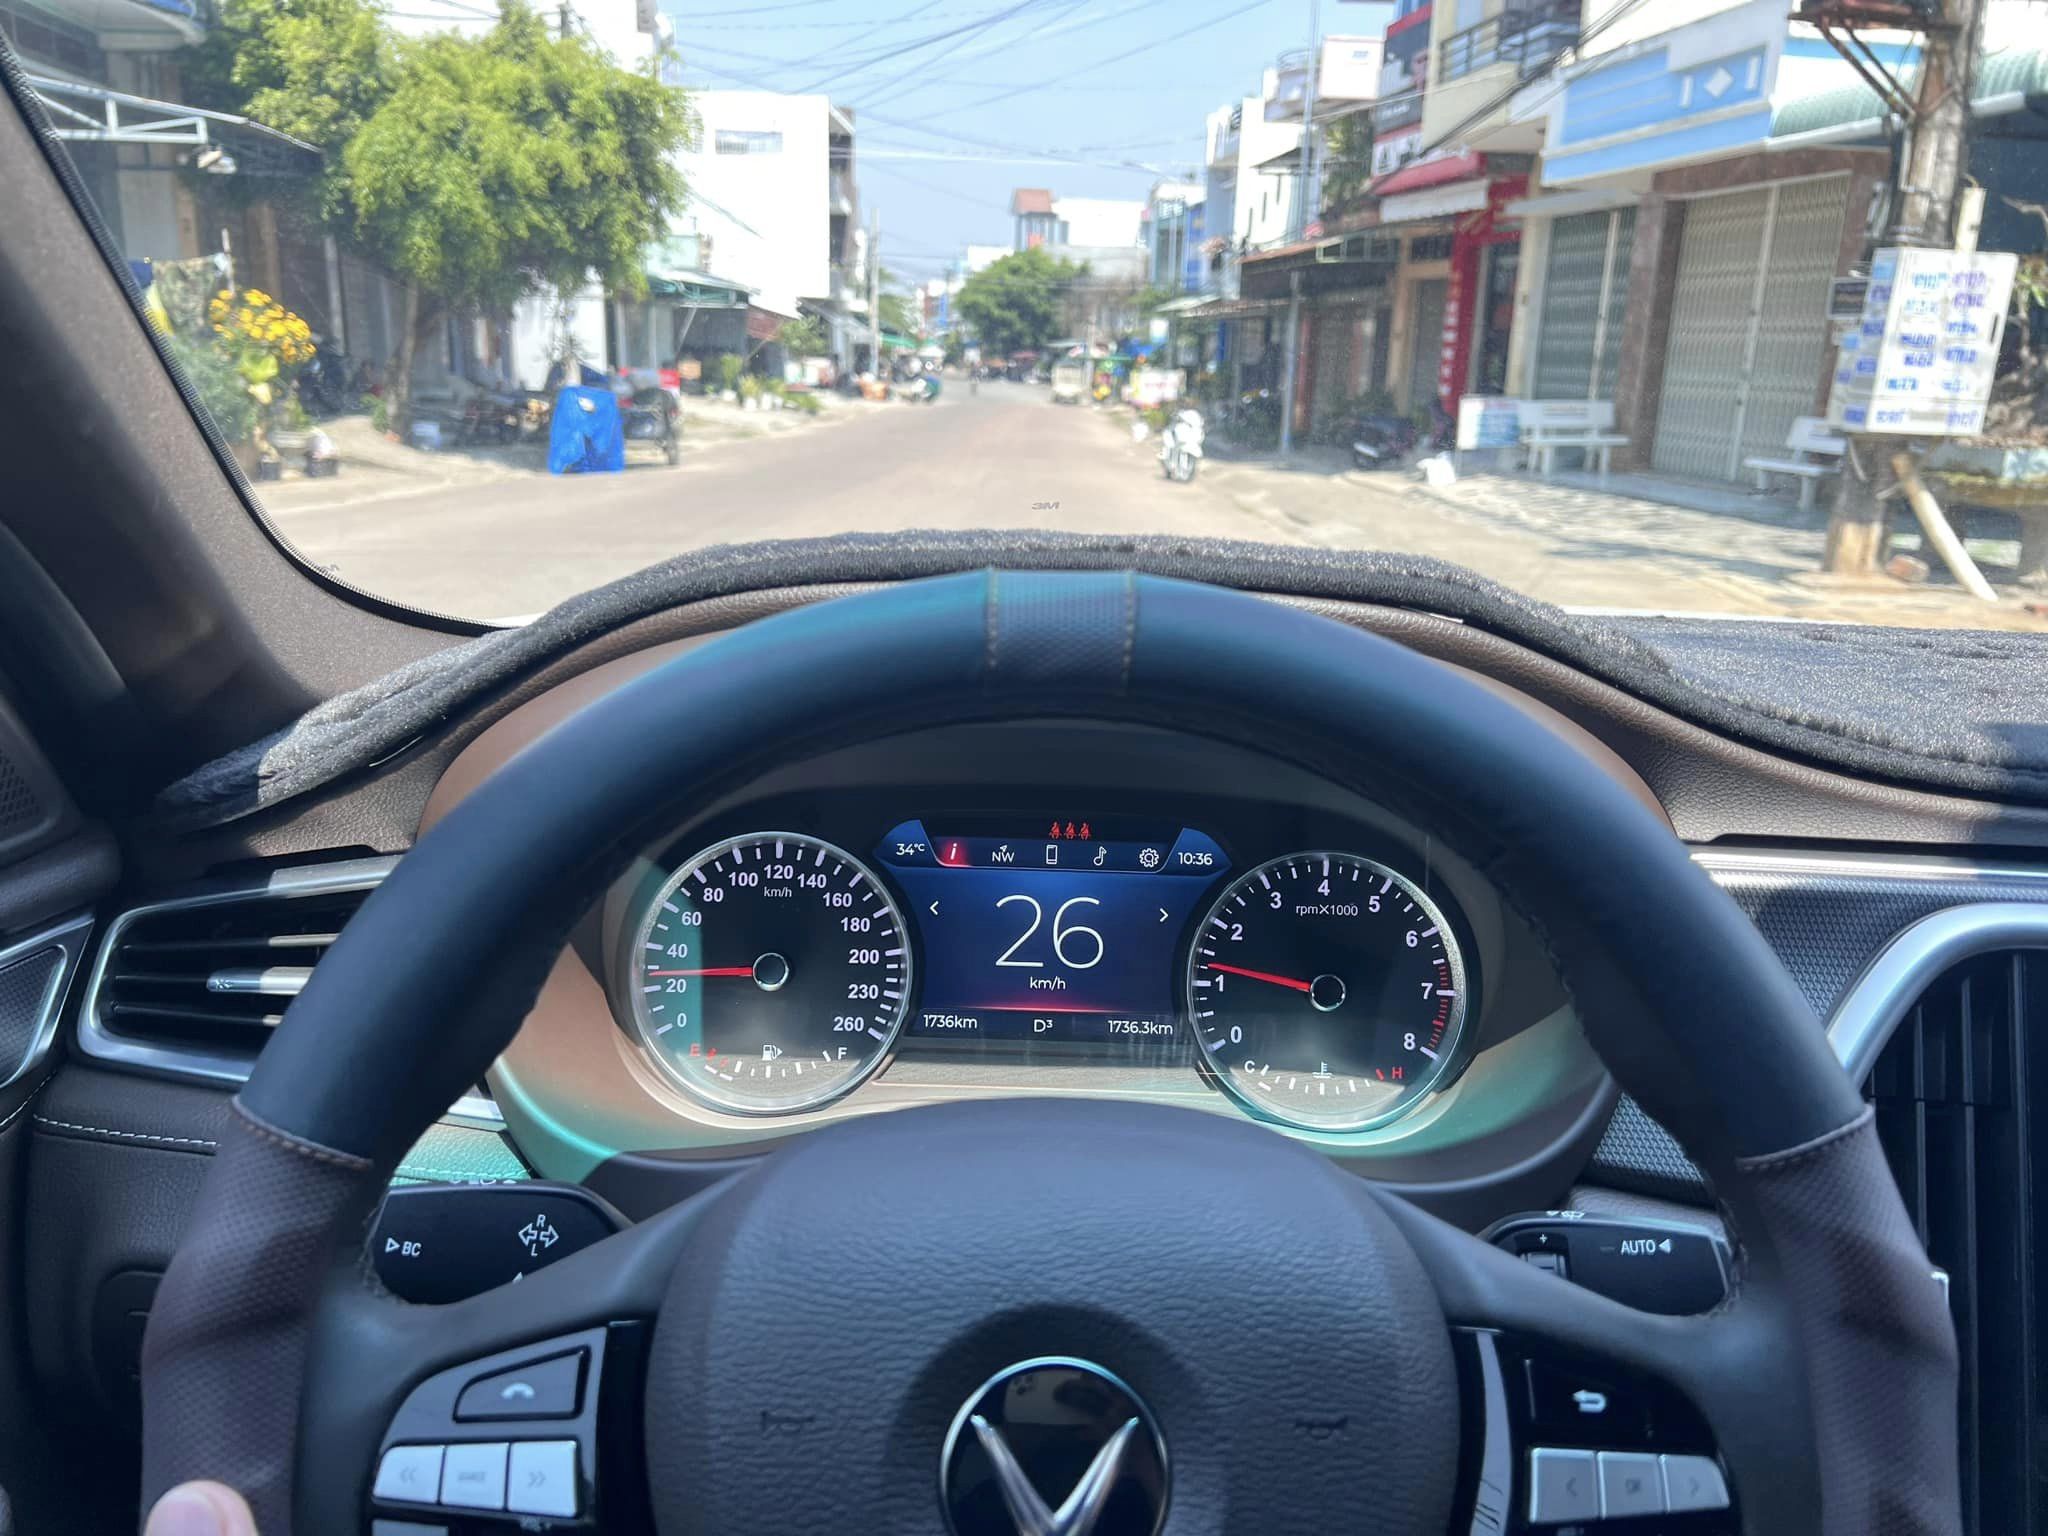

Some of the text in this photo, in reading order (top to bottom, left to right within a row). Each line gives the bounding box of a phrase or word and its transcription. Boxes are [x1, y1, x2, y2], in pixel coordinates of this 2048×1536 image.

[991, 851, 1015, 863] NW
[1177, 852, 1213, 866] 10:36
[728, 872, 758, 887] 100
[763, 865, 794, 880] 120
[797, 873, 827, 889] 140
[1318, 879, 1330, 896] 4
[703, 888, 724, 902] 80
[763, 886, 793, 898] km/h
[823, 892, 853, 908] 160
[1270, 892, 1282, 909] 3
[1368, 895, 1381, 913] 5
[681, 911, 702, 926] 60
[840, 917, 871, 932] 180
[995, 894, 1104, 969] 26
[1230, 923, 1243, 941] 2
[1405, 930, 1418, 947] 6
[667, 943, 688, 958] 40
[848, 949, 880, 965] 200
[666, 978, 687, 994] 20
[1029, 976, 1066, 991] km/h
[1215, 975, 1224, 992] 1
[1421, 982, 1433, 999] 7
[848, 984, 879, 1000] 230
[677, 1012, 687, 1028] 0
[833, 1016, 865, 1032] 260
[923, 1014, 978, 1029] 1736km
[1107, 1019, 1173, 1036] 1736.3km
[1230, 1026, 1242, 1043] 0
[1403, 1033, 1416, 1050] 8
[690, 1044, 701, 1057] E
[837, 1047, 848, 1060] F
[1244, 1060, 1255, 1074] C
[1392, 1067, 1403, 1080] H
[536, 1213, 546, 1227] R
[401, 1241, 422, 1257] BC
[531, 1243, 538, 1257] L
[1621, 1239, 1656, 1255] AUTO
